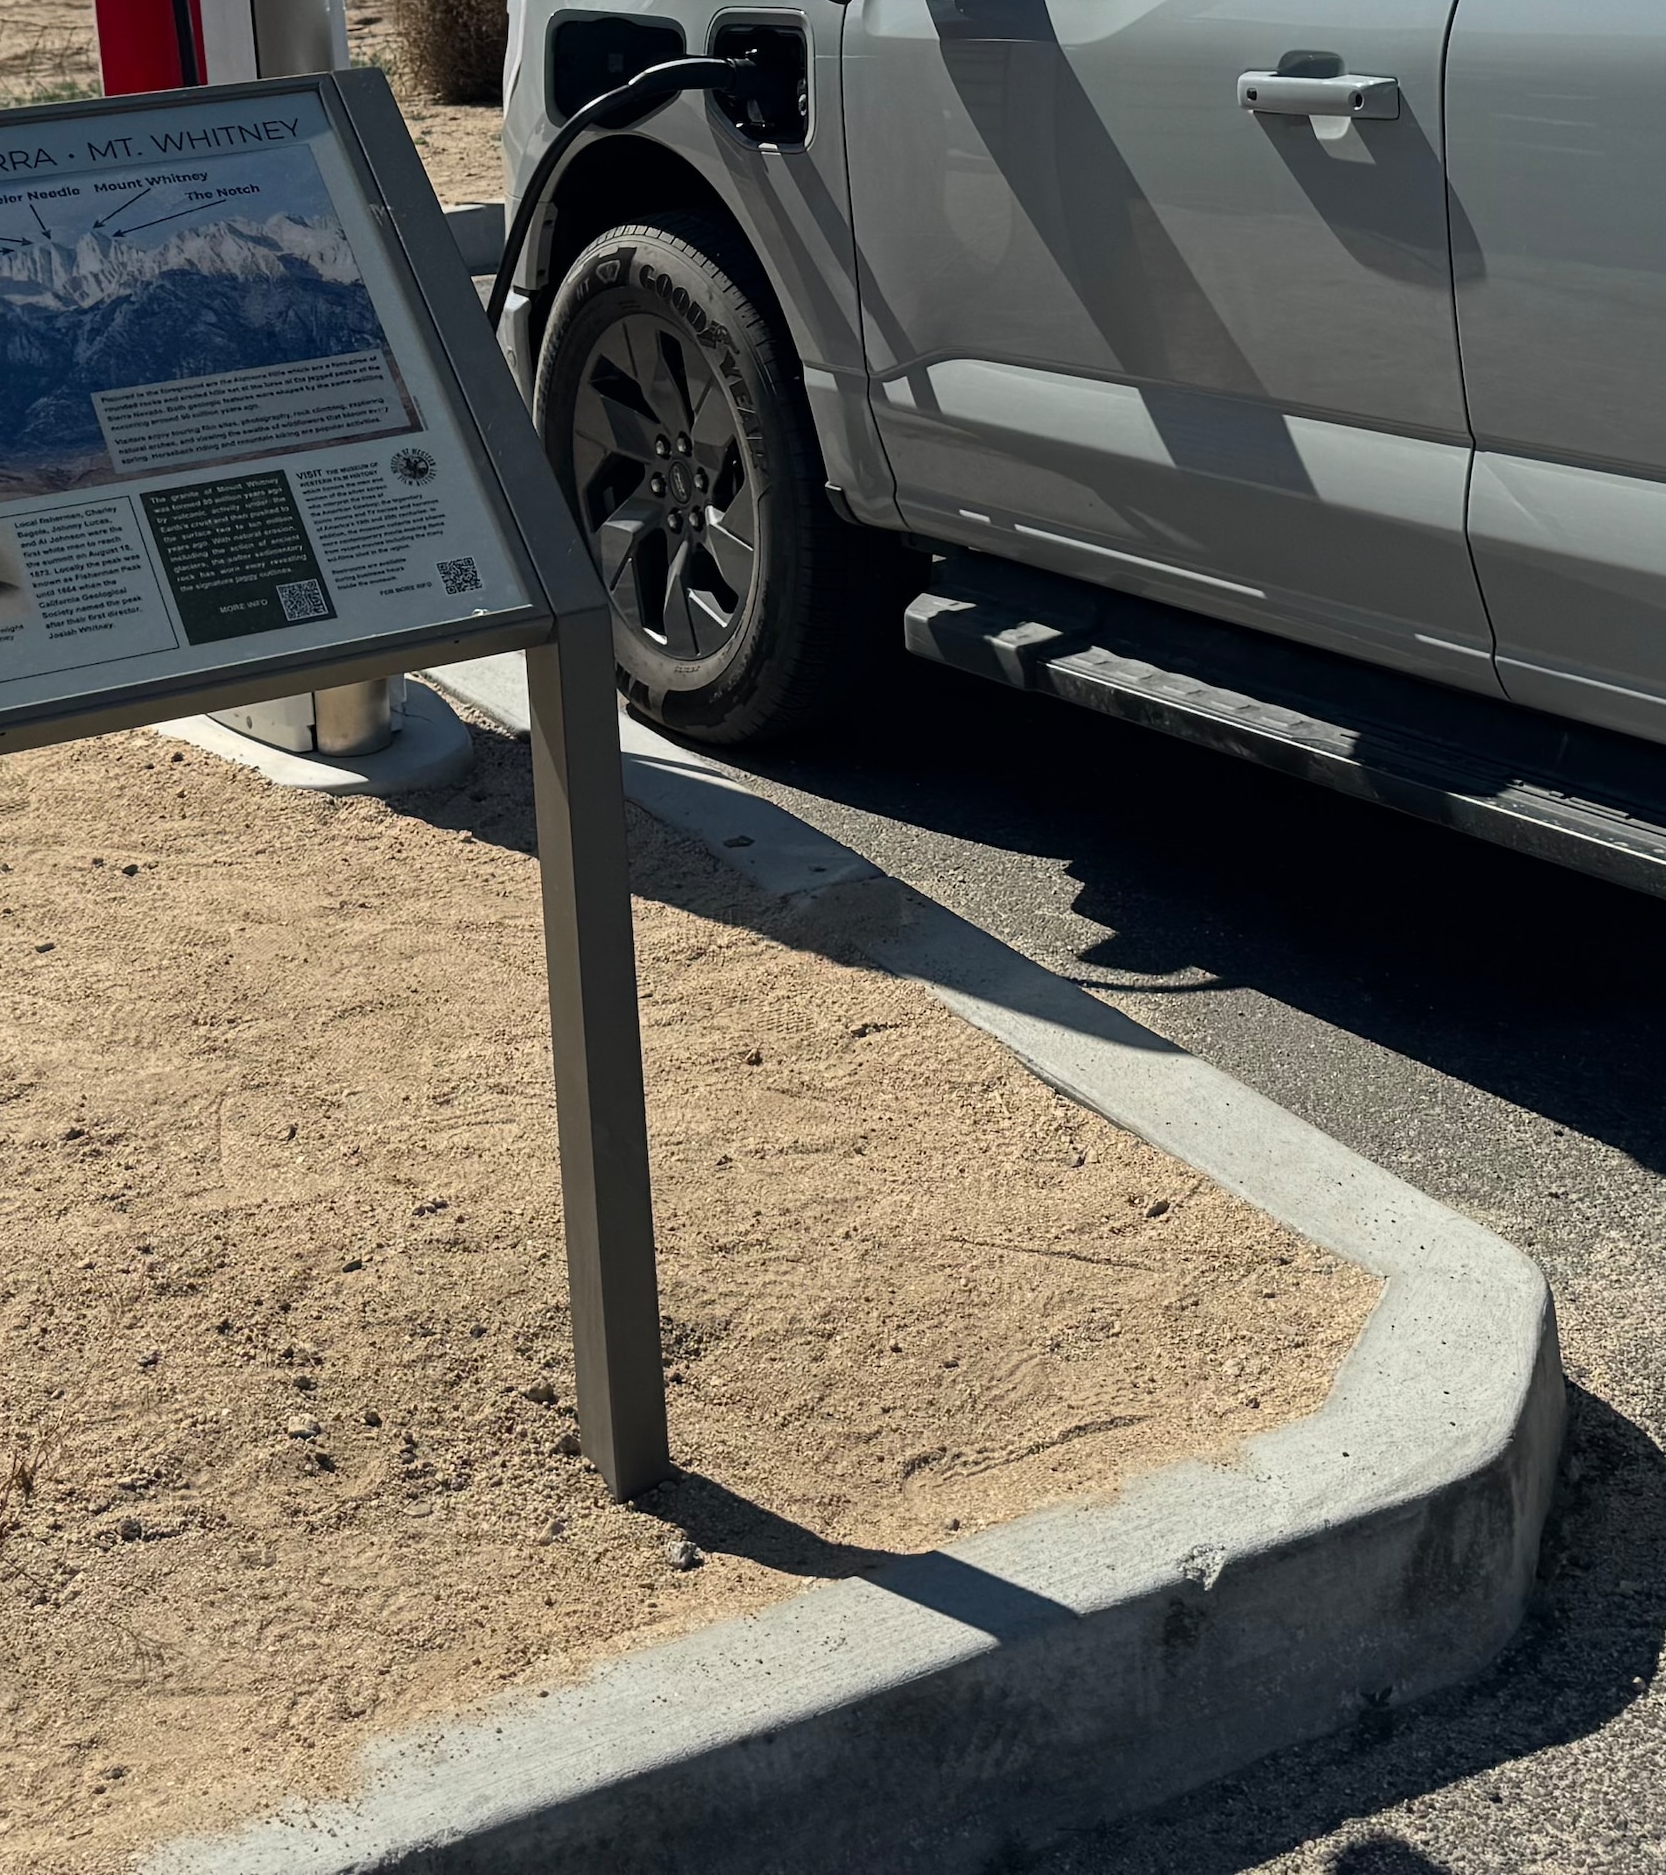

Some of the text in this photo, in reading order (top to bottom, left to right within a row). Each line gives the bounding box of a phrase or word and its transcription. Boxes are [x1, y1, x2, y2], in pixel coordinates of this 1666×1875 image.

[87, 137, 143, 161] MT.
[149, 118, 299, 153] WHITNEY
[93, 172, 208, 192] Mount Whitney
[26, 186, 80, 200] Needle
[184, 183, 261, 200] The Notch
[295, 468, 322, 479] VISIT
